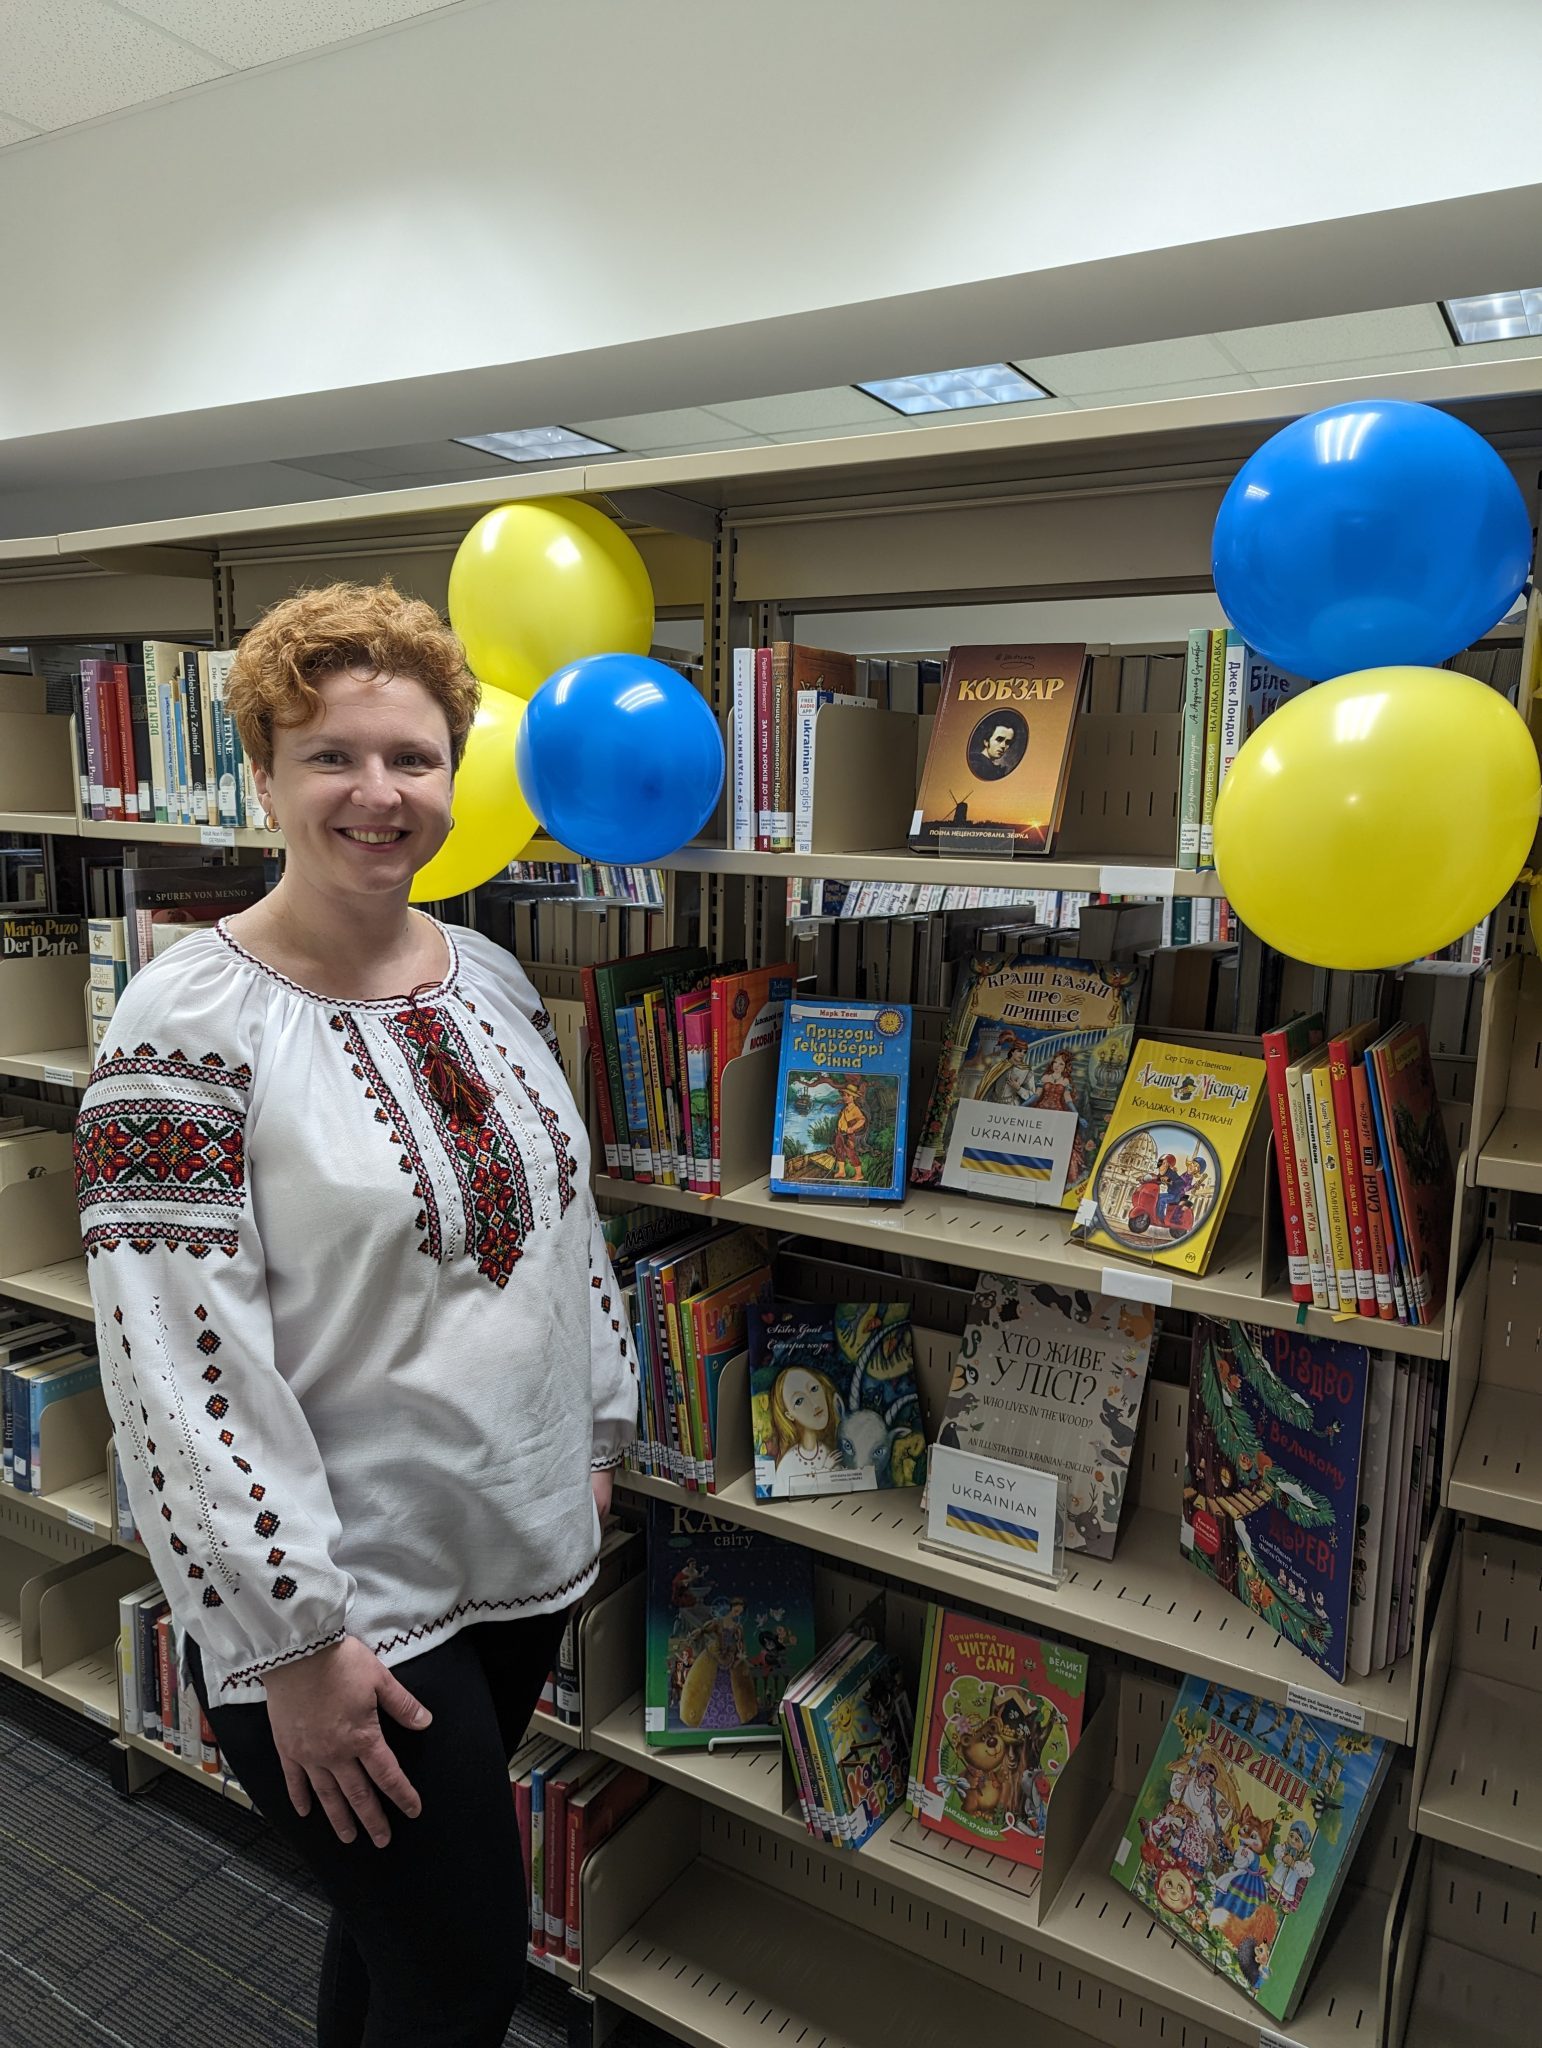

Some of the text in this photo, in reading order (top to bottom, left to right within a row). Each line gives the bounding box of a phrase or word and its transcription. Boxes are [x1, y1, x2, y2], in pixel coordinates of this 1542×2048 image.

[144, 644, 160, 736] DEIN LEBEN LANG
[958, 676, 1065, 701] КОБЗАР
[1209, 637, 1224, 732] НАТАЛКА ПОЛТАВКА
[1251, 665, 1290, 693] Біле
[187, 664, 201, 756] Hildebrand's Zeittafel
[1225, 661, 1241, 745] Джек Лондон
[761, 719, 767, 729] ЗА
[803, 719, 811, 775] ukrainian
[762, 783, 769, 794] ДО
[1204, 742, 1216, 812] КОТЛЯРЕВСЬКИЙ
[802, 775, 811, 812] english
[951, 830, 1005, 838] НЕЦЕНЗУРОВАНА
[155, 889, 248, 901] SPUREN VON MENNO
[3, 919, 79, 937] Mario Puzo
[3, 936, 79, 957] Der Pate
[987, 972, 1111, 999] КРАЩІ КАЗКИ
[1026, 990, 1062, 1004] ПРО
[820, 1010, 838, 1018] Марк
[1001, 1003, 1080, 1024] ПРИНЦЕС
[805, 1023, 875, 1043] Пригоди
[812, 1052, 863, 1069] Фінна
[1165, 1054, 1232, 1071] Сер Стів Стівенсон
[1137, 1063, 1249, 1108] Агата Містері
[986, 1114, 1043, 1130] JUVENILE
[970, 1126, 1055, 1147] UKRAINIAN
[1301, 1157, 1317, 1232] КУДИ ЗНИКЛО МОРЕ
[1366, 1174, 1380, 1213] СЛОН
[1330, 1181, 1345, 1261] ТАЄМНИЦЯ ФАРАОНА
[766, 1323, 824, 1337] Sister Goat
[997, 1330, 1106, 1373] ХТО ЖИВЕ
[991, 1356, 1098, 1406] У ЛІСІ?
[982, 1395, 1094, 1429] WHO LIVES IN THE WOOD?
[968, 1437, 978, 1446] AN
[978, 1438, 1025, 1458] ILLUSTRATED
[1024, 1449, 1094, 1475] UKRAINIAN-ENGLISH
[974, 1470, 1017, 1492] EASY
[951, 1483, 1038, 1518] UKRAINIAN
[714, 1534, 754, 1549] світу
[160, 1634, 168, 1662] AUGEN
[957, 1641, 1015, 1660] ЧИТАТИ
[975, 1655, 1014, 1675] САМІ
[1049, 1656, 1082, 1674] ВЕЛИКІ
[161, 1664, 170, 1697] CHARLYS
[1288, 1691, 1307, 1702] Please
[1317, 1700, 1333, 1710] books
[1333, 1707, 1343, 1715] you
[1318, 1708, 1332, 1717] ends
[1338, 1715, 1360, 1726] shelves
[1206, 1716, 1312, 1811] УКРАЇНИ
